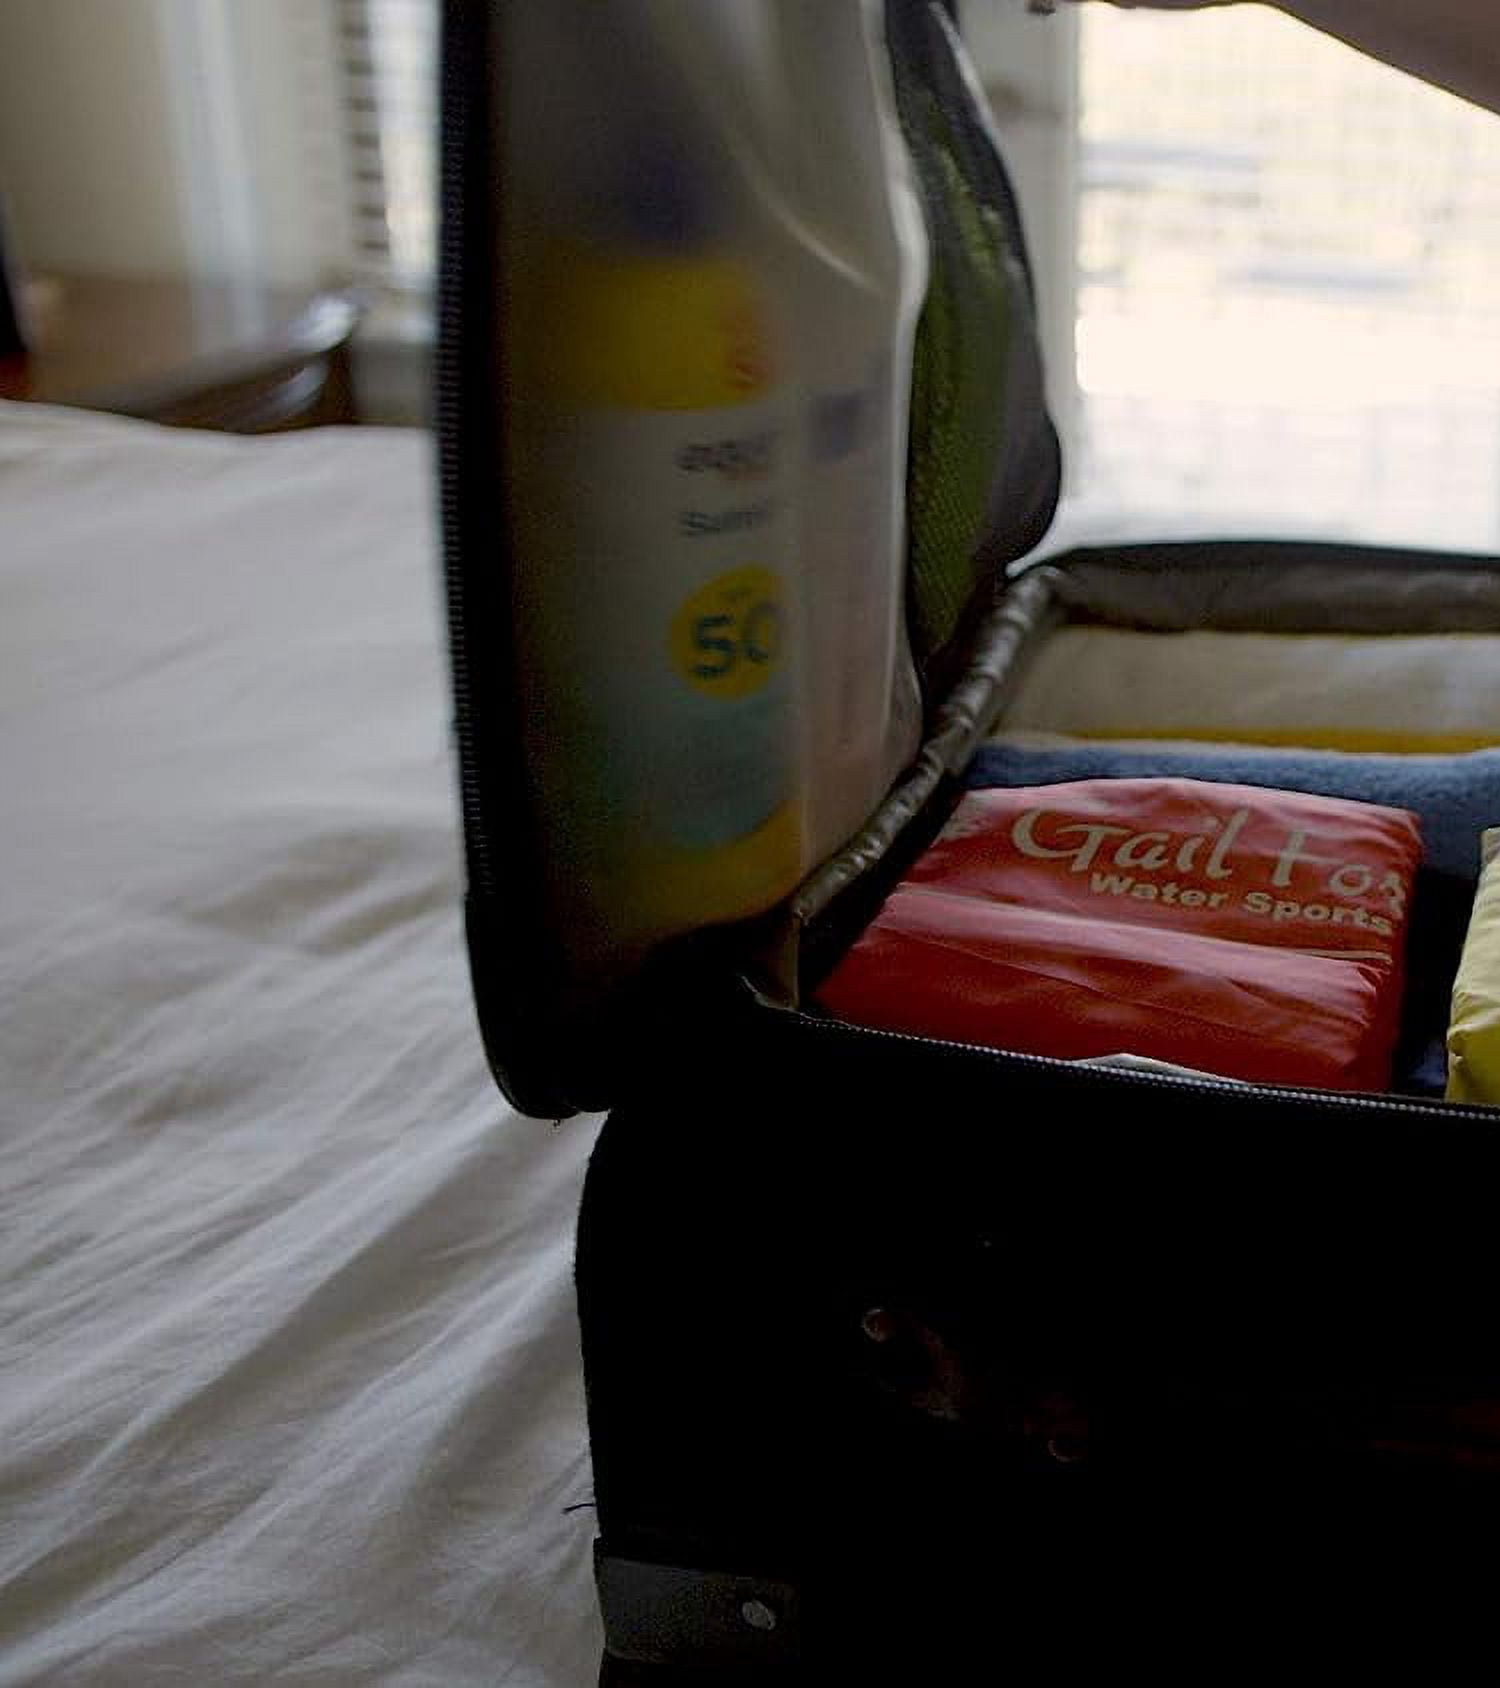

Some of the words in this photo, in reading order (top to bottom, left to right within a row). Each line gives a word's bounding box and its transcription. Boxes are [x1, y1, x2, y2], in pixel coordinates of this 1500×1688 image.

[1011, 808, 1250, 881] Gail
[1088, 871, 1227, 908] Water
[1246, 891, 1393, 937] Sports
